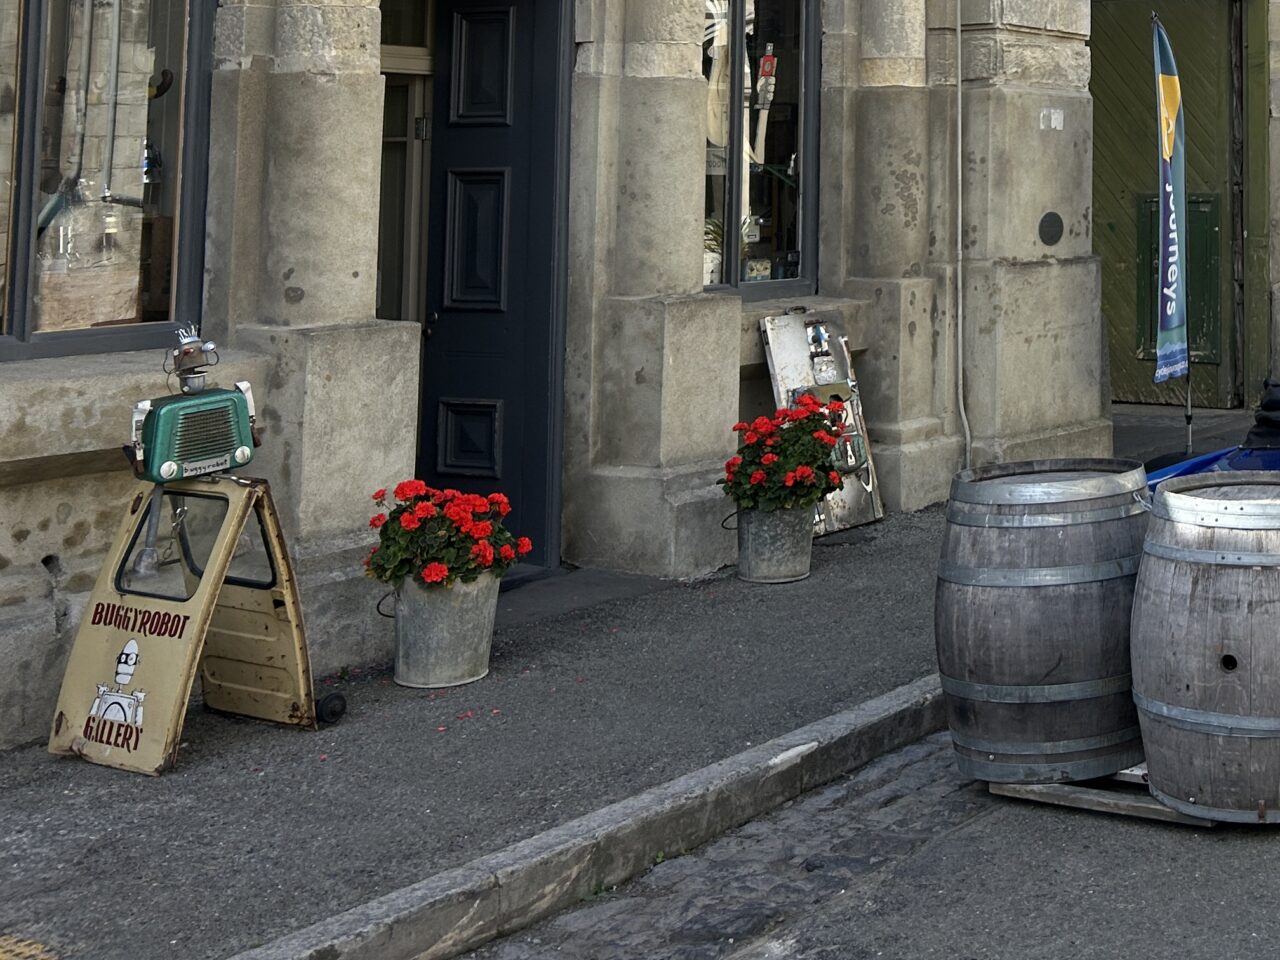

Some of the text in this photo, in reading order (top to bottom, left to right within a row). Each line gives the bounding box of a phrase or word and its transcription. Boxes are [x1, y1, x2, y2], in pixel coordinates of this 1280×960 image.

[184, 458, 228, 475] buggyrobot
[91, 602, 190, 639] BUGGYROBOT
[83, 716, 143, 753] GALLERY
